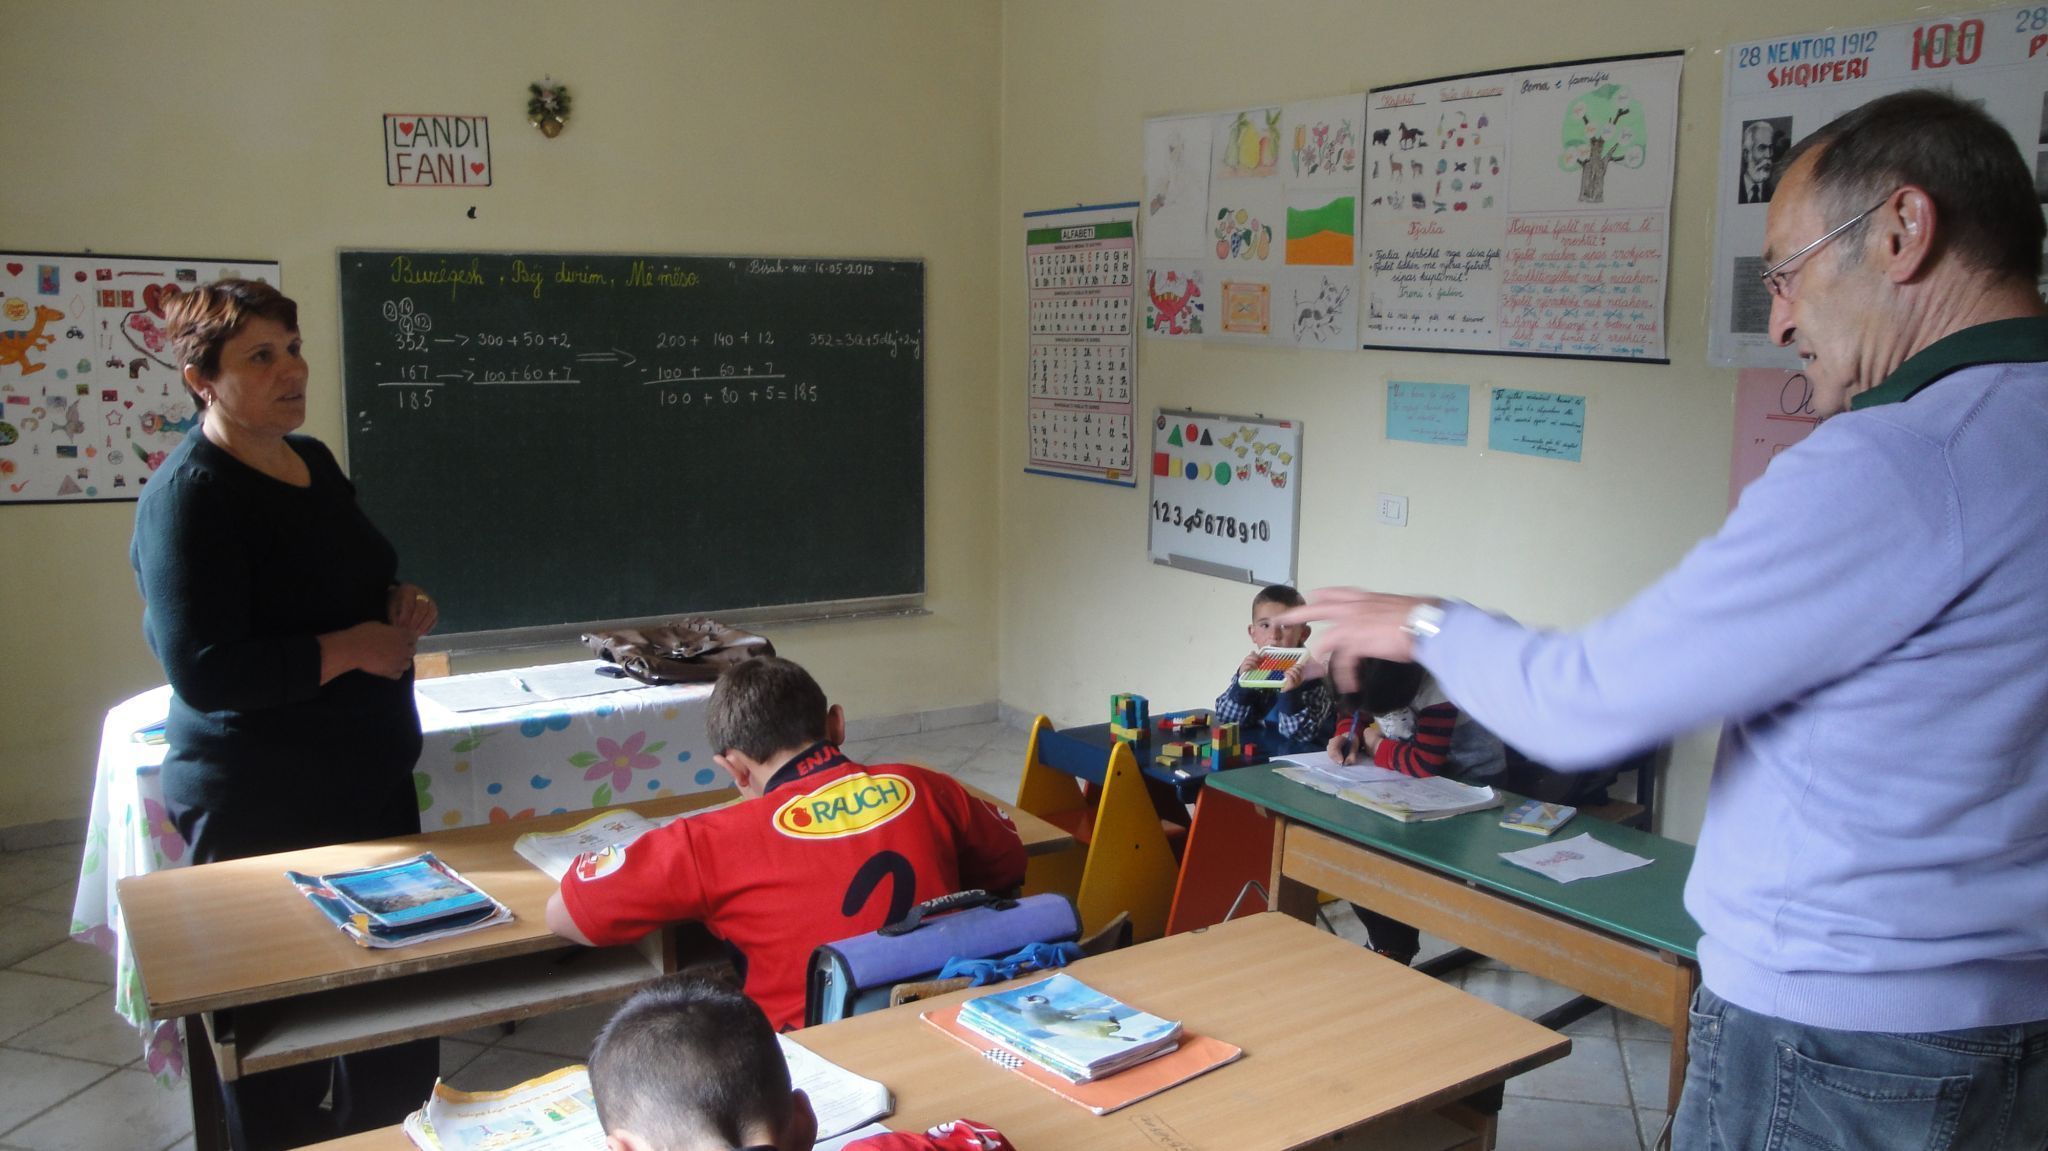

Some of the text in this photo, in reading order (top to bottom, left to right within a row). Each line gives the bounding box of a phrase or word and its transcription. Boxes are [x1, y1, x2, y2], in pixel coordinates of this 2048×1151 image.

[1739, 30, 1879, 69] 28 NENTOR 1912
[1911, 19, 1985, 70] 100
[1767, 57, 1870, 88] SHQIPERI
[393, 116, 479, 148] LANDI
[396, 153, 467, 184] FANI
[1063, 228, 1095, 241] ALFABETI
[395, 332, 429, 352] 352
[401, 364, 429, 380] 167
[399, 389, 434, 411] 185
[814, 781, 901, 825] RAUCH
